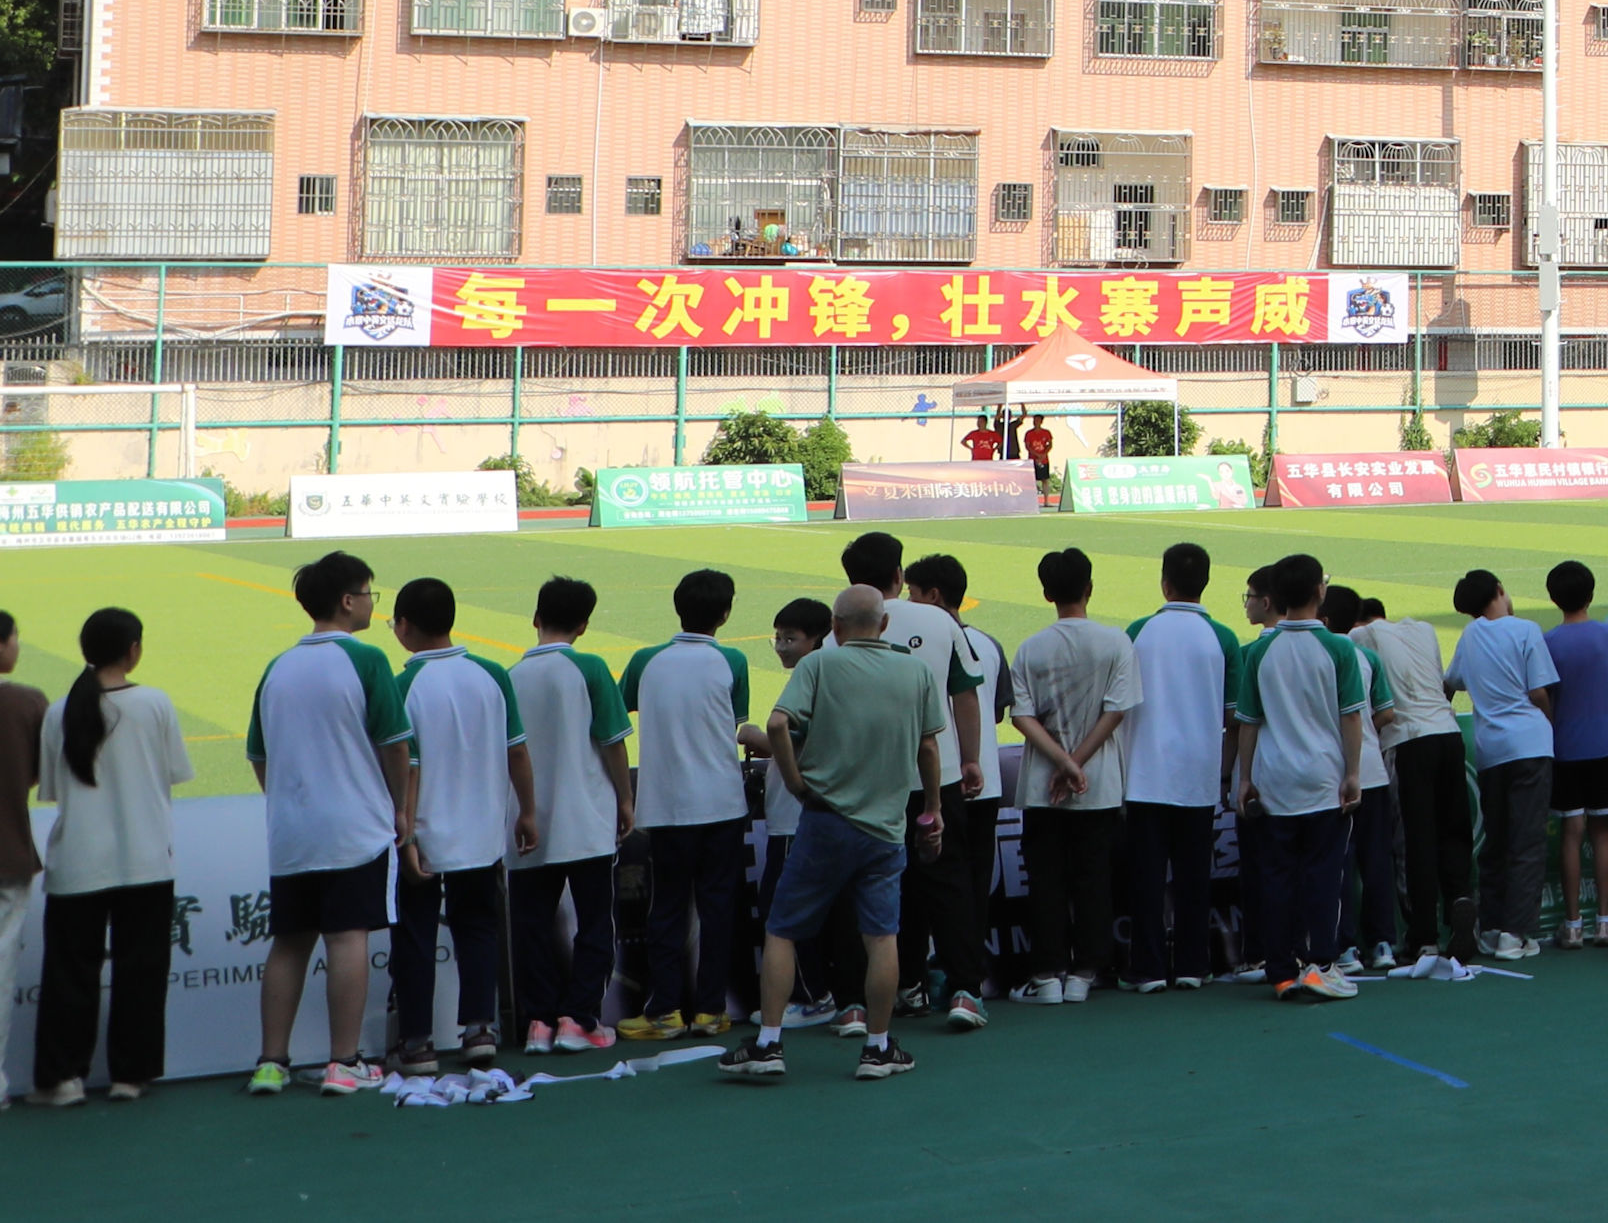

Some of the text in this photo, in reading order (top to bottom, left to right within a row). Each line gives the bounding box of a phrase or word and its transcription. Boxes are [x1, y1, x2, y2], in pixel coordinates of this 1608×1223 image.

[1286, 459, 1436, 479] 五华县长安实业发展
[648, 469, 794, 492] 领航托管中心
[1327, 481, 1405, 499] 有限公司
[1557, 478, 1588, 487] VILLAGE
